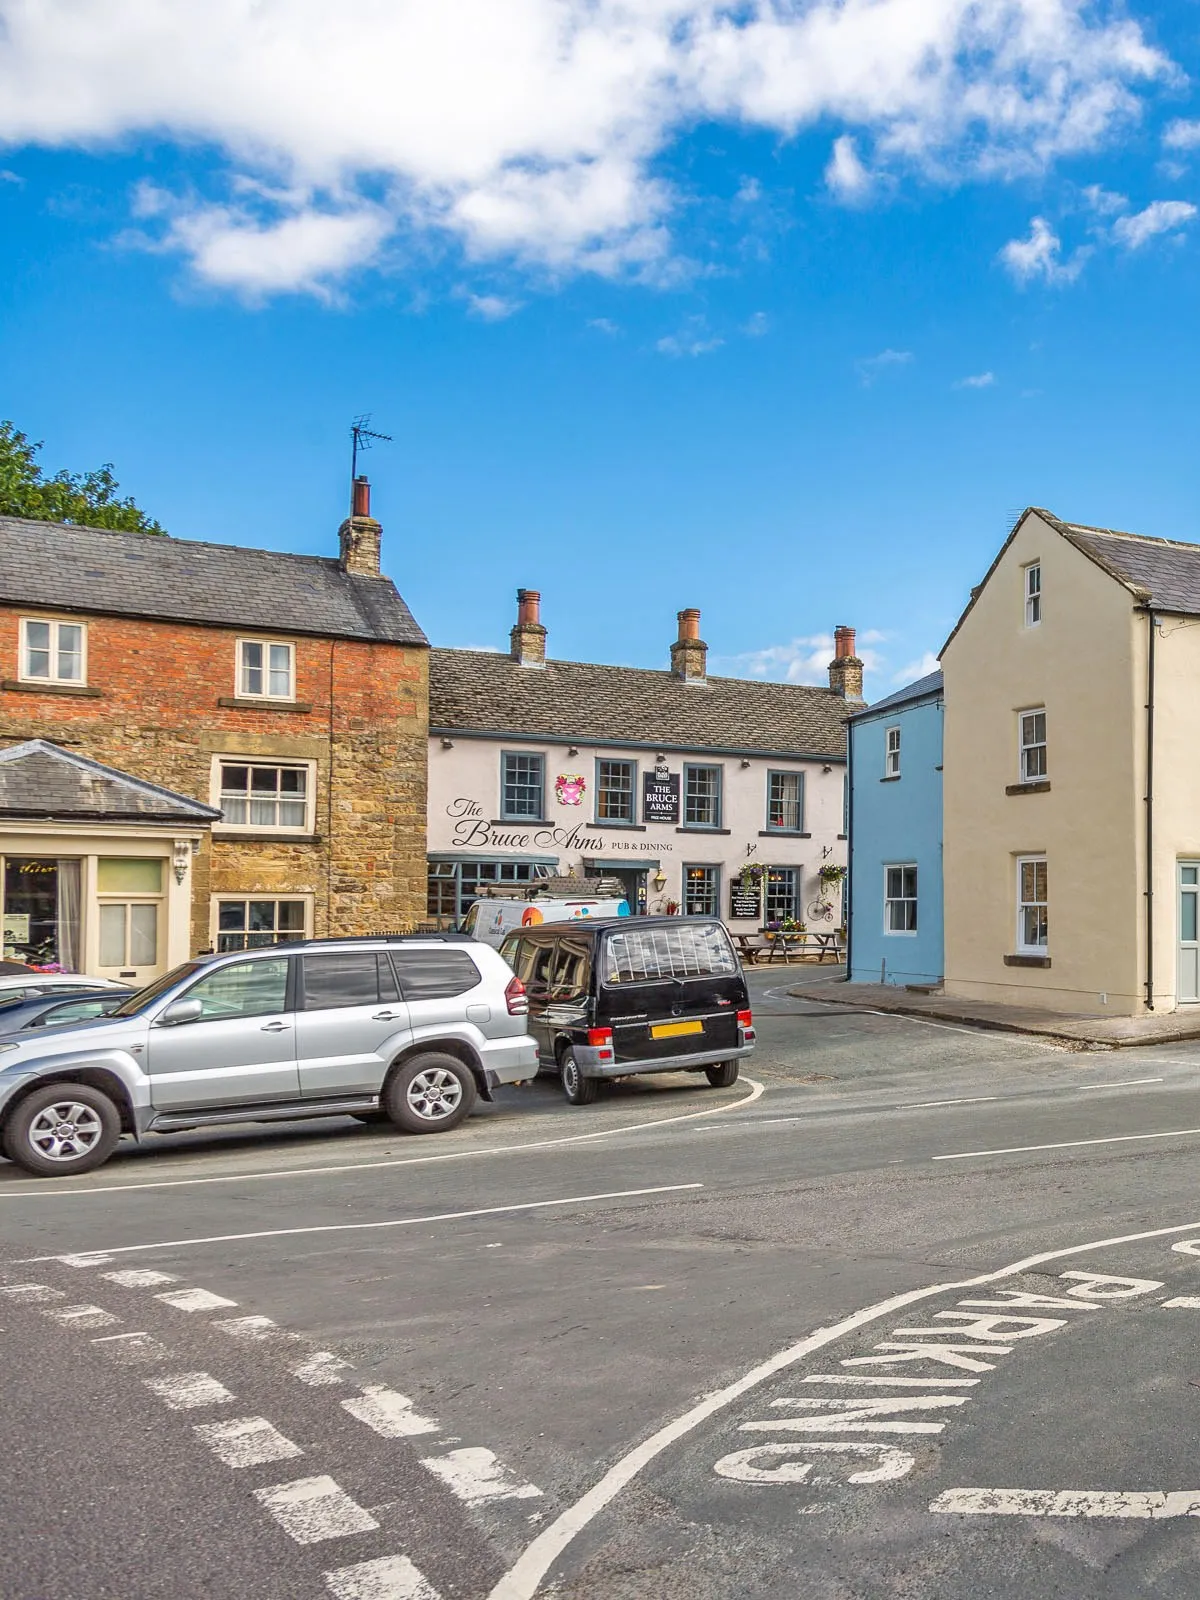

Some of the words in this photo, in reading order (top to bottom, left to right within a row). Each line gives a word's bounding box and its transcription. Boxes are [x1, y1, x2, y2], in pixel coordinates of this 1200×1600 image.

[653, 785, 671, 794] THE
[646, 793, 678, 803] BRUCE
[446, 798, 483, 818] The
[650, 803, 673, 811] ARMS
[452, 819, 530, 848] Bruce
[533, 822, 607, 851] Arms
[611, 842, 630, 850] PUB
[631, 842, 638, 850] &
[640, 843, 673, 851] DINING
[713, 1270, 1165, 1485] PARKING
